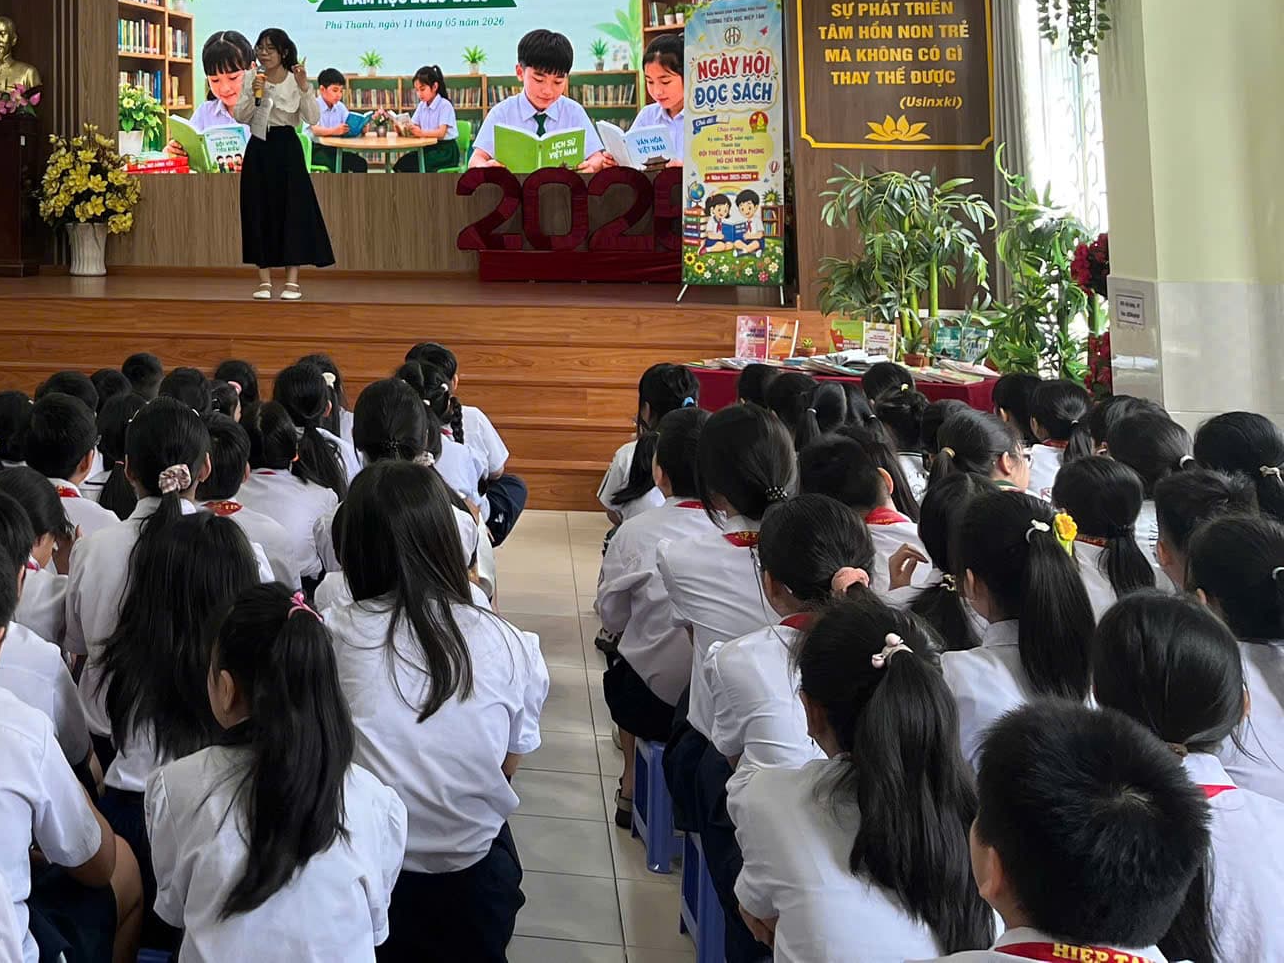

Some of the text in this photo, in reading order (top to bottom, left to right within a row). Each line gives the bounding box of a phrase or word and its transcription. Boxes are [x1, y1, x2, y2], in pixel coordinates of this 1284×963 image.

[831, 2, 855, 20] SỰ
[858, 0, 900, 16] PHÁT
[403, 18, 413, 28] 11
[445, 17, 457, 27] 05
[481, 16, 504, 27] 2026
[818, 23, 854, 40] TÂM
[897, 24, 934, 38] NON
[938, 20, 969, 38] TRẺ
[856, 45, 913, 62] KHÔNG
[697, 50, 771, 79] NGÀY HỘI
[831, 66, 956, 87] THAY THẾ ĐƯỢC
[694, 78, 773, 108] ĐỌC SÁCH
[563, 147, 578, 157] NAM
